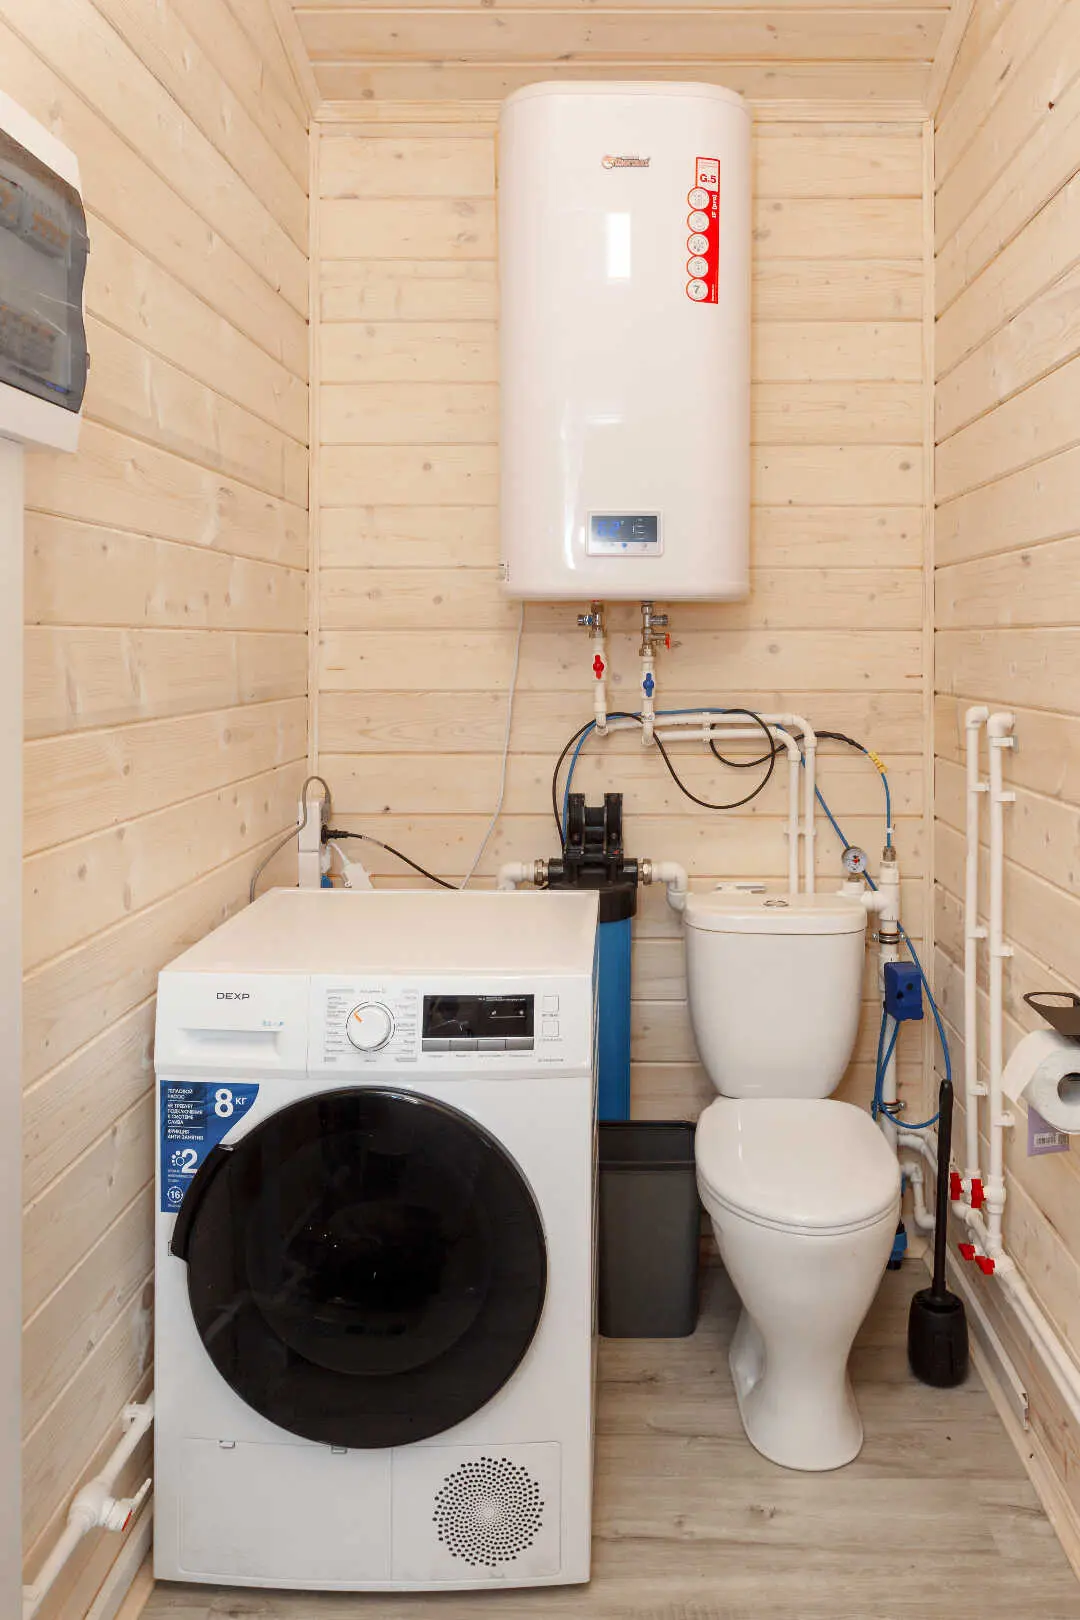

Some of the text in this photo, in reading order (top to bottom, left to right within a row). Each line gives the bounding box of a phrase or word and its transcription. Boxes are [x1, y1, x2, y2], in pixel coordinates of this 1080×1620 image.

[700, 173, 717, 184] G.5
[216, 992, 250, 1000] DEXP
[214, 1088, 234, 1118] 8
[181, 1148, 198, 1174] 2
[170, 1190, 180, 1199] 16
